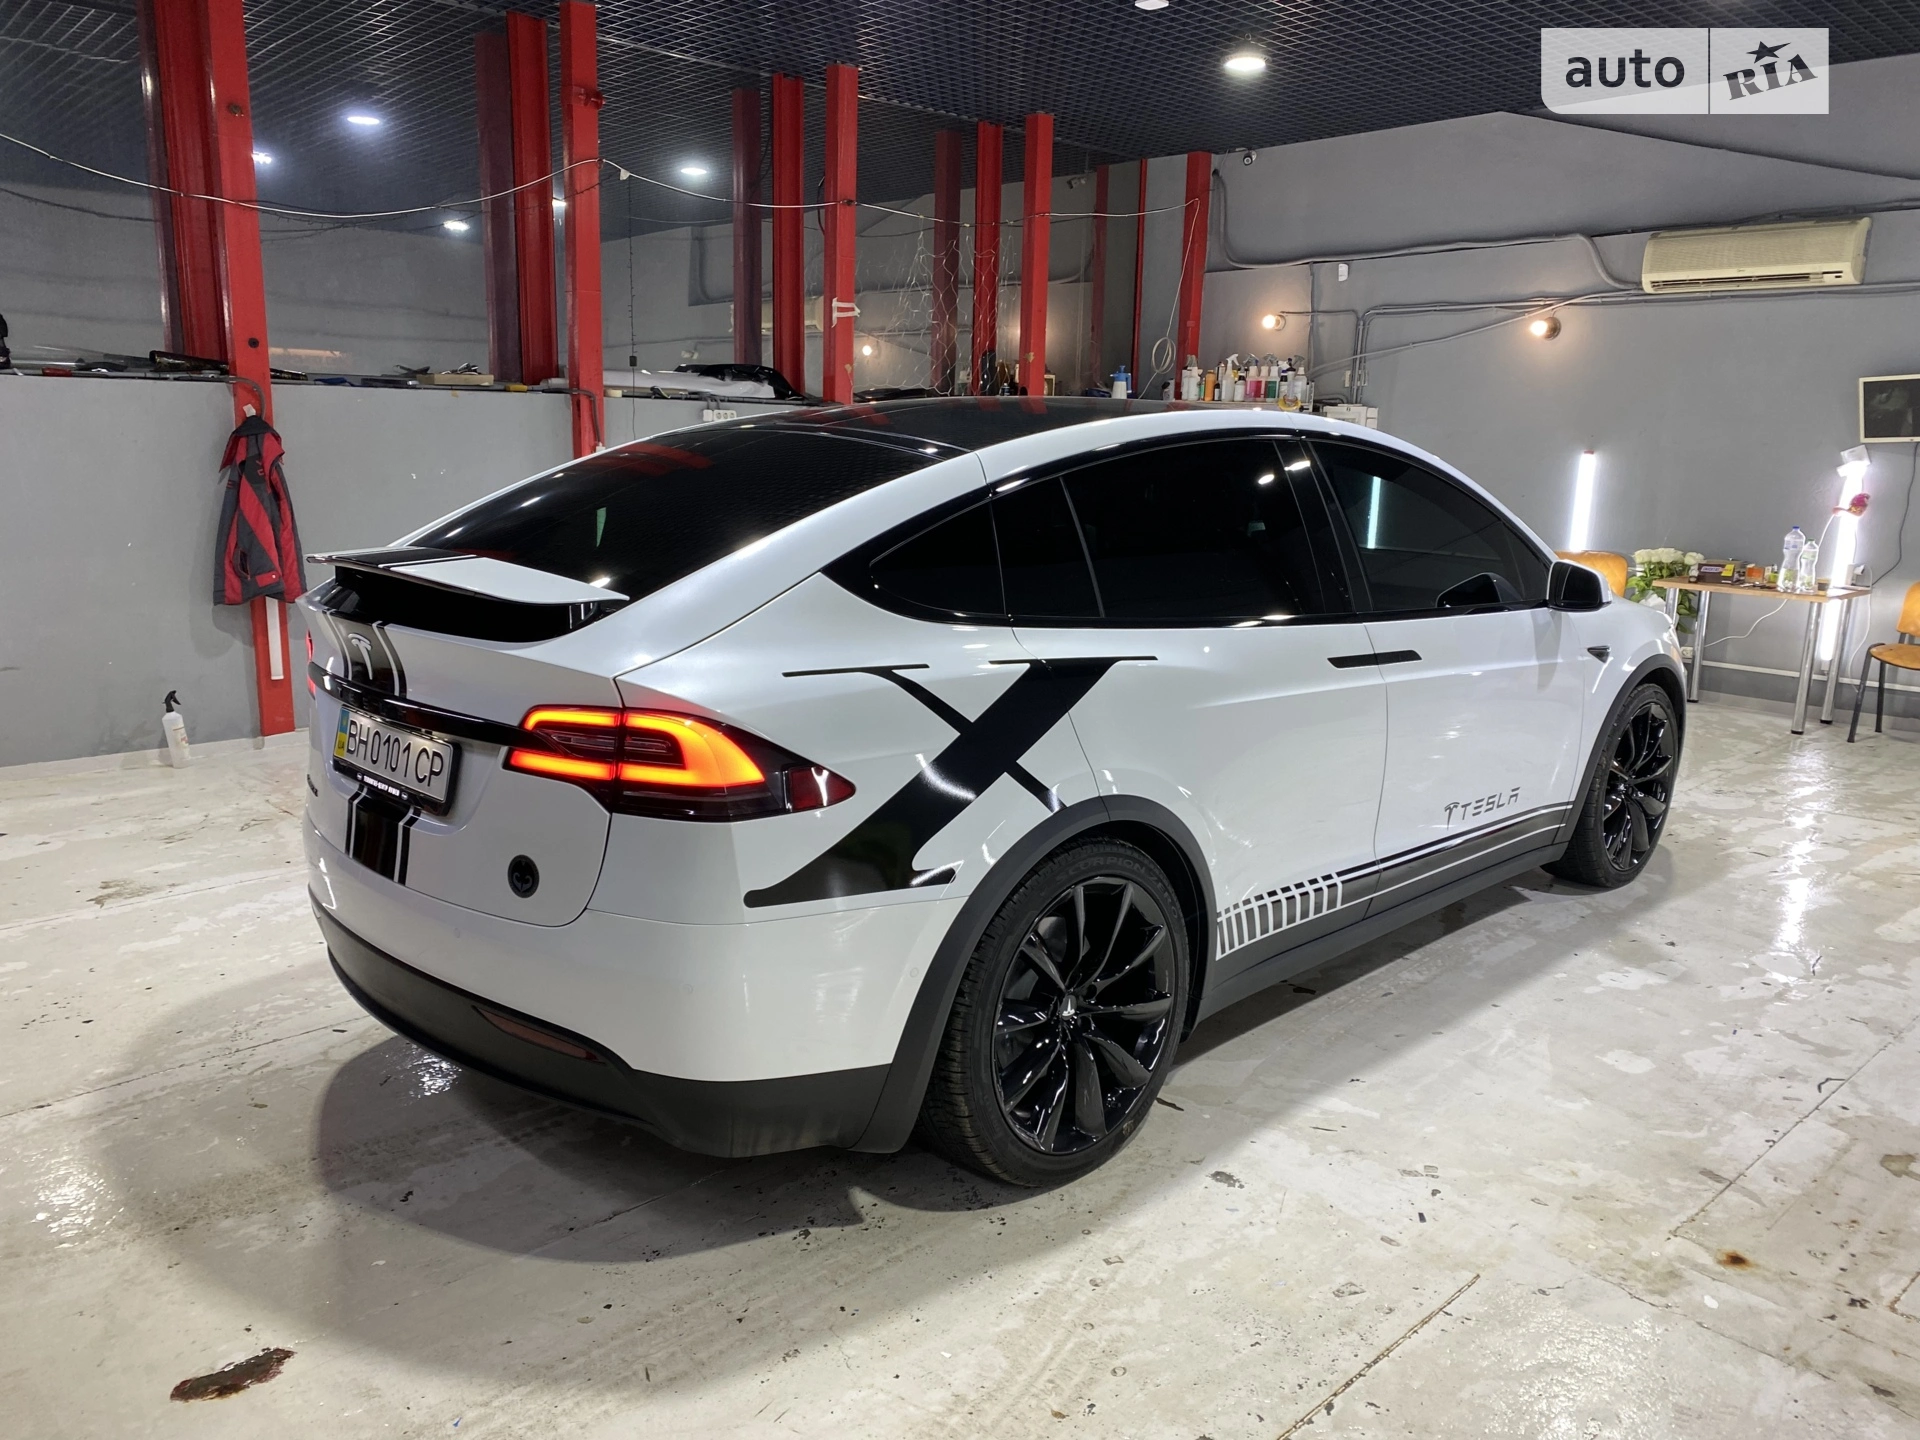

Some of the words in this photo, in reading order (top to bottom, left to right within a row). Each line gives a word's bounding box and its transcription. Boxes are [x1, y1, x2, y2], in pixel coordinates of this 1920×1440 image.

[346, 719, 371, 761] BH
[370, 730, 411, 777] 0101
[415, 747, 444, 787] CP
[1460, 786, 1521, 820] TESLA
[1055, 856, 1146, 884] SCORPION
